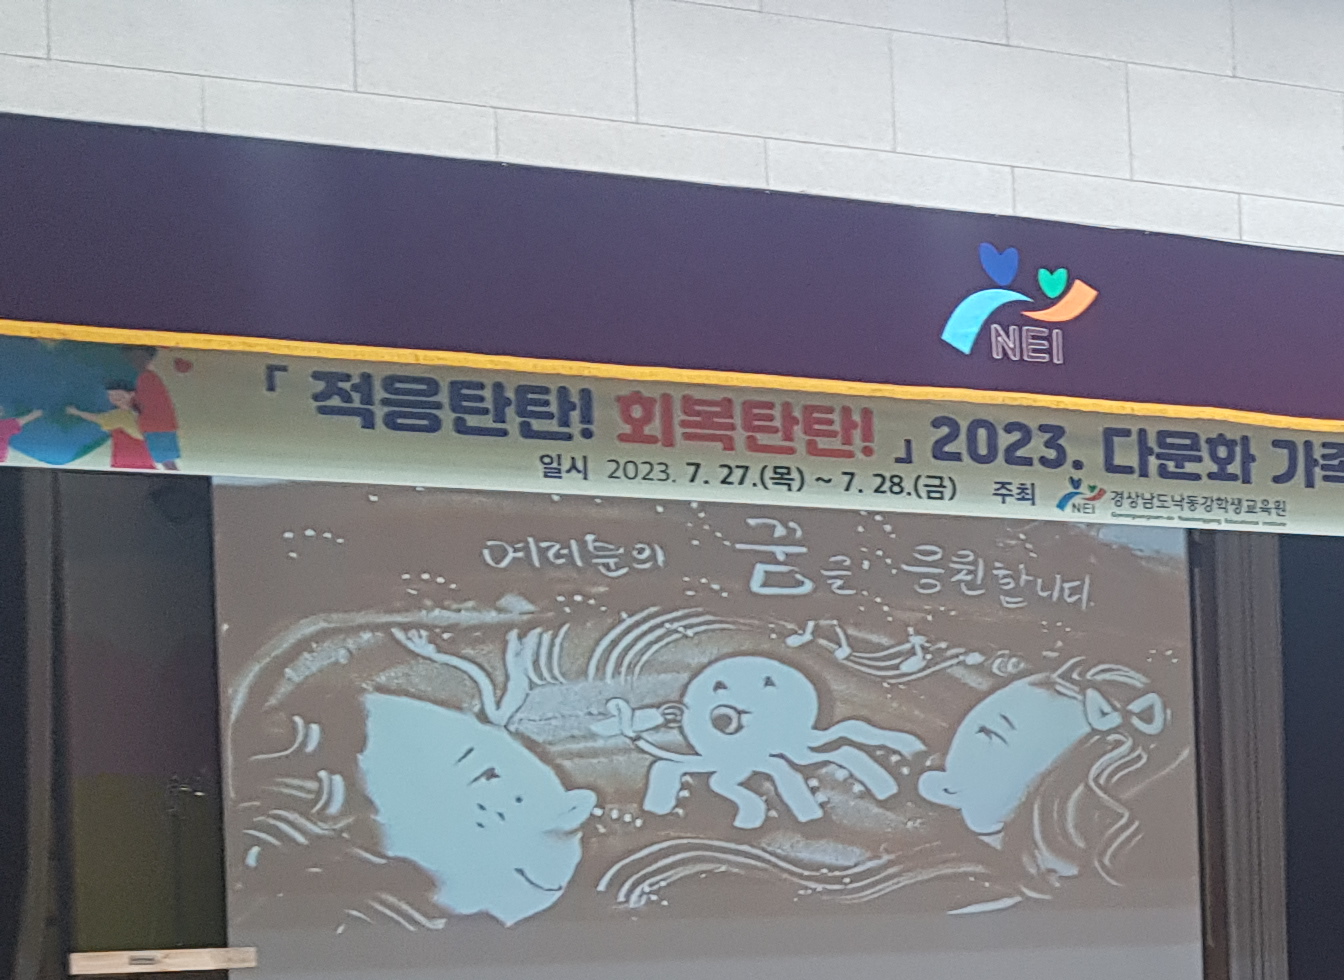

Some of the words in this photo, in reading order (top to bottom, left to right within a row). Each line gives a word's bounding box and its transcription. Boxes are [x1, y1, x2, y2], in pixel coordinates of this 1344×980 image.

[990, 323, 1064, 365] NEI
[310, 370, 595, 441] 적응탄탄!
[615, 390, 876, 458] 회복탄탄!
[930, 415, 1085, 470] 2023.
[1102, 426, 1257, 485] 다문화
[539, 453, 589, 481] 일시
[606, 459, 677, 483] 2023.
[686, 462, 710, 485] 7.
[720, 464, 806, 493] 27.(목)
[841, 471, 864, 494] 7.
[873, 472, 957, 501] 28.(금)
[992, 480, 1036, 506] 주최
[1110, 490, 1287, 517] 경상남도낙동강학생교육원
[1071, 502, 1096, 515] NEI
[482, 533, 665, 577] 여러분의
